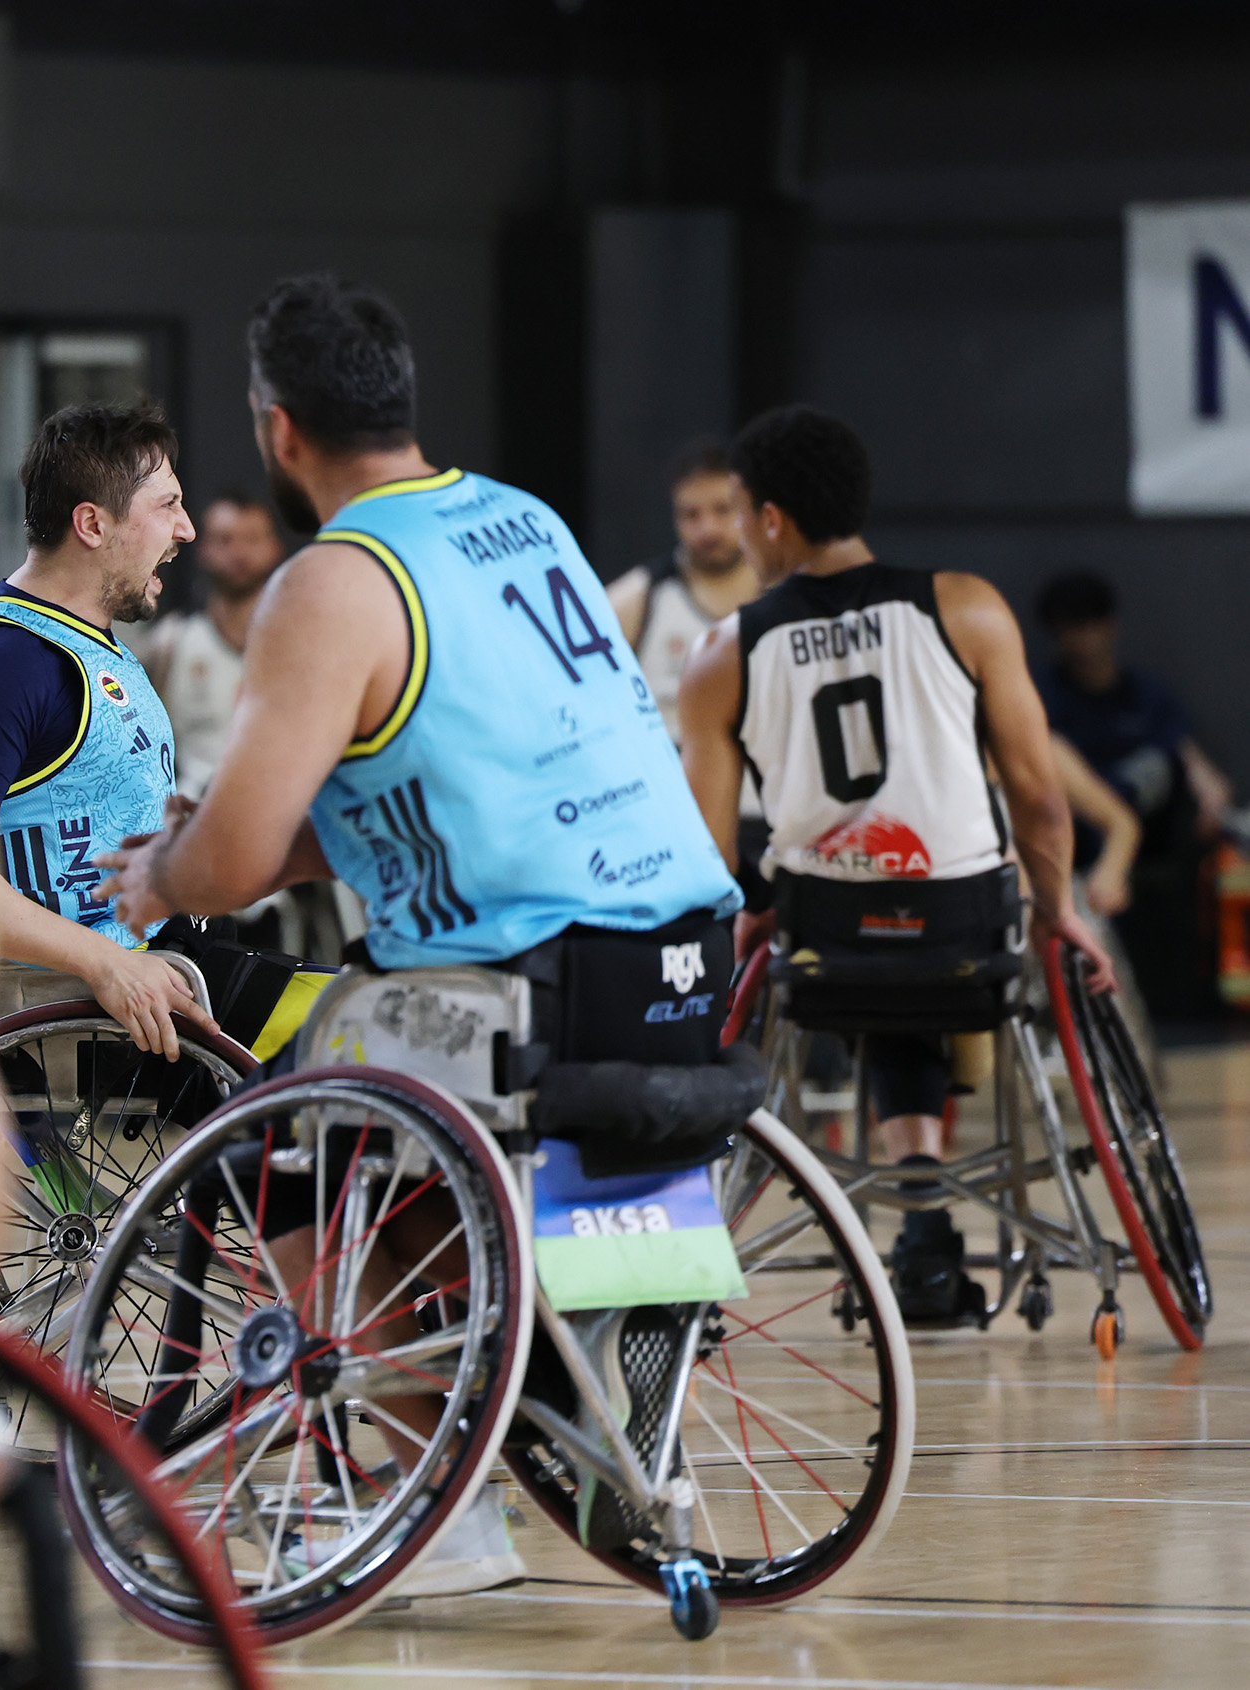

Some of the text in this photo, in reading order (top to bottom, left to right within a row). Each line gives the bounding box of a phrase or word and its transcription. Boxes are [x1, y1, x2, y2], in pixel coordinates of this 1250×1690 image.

[447, 510, 558, 567] YAMAÇ
[502, 566, 619, 683] 14
[790, 612, 882, 665] BROWN
[812, 674, 887, 803] 0
[644, 993, 715, 1023] ELITE
[570, 1203, 670, 1238] aksa
